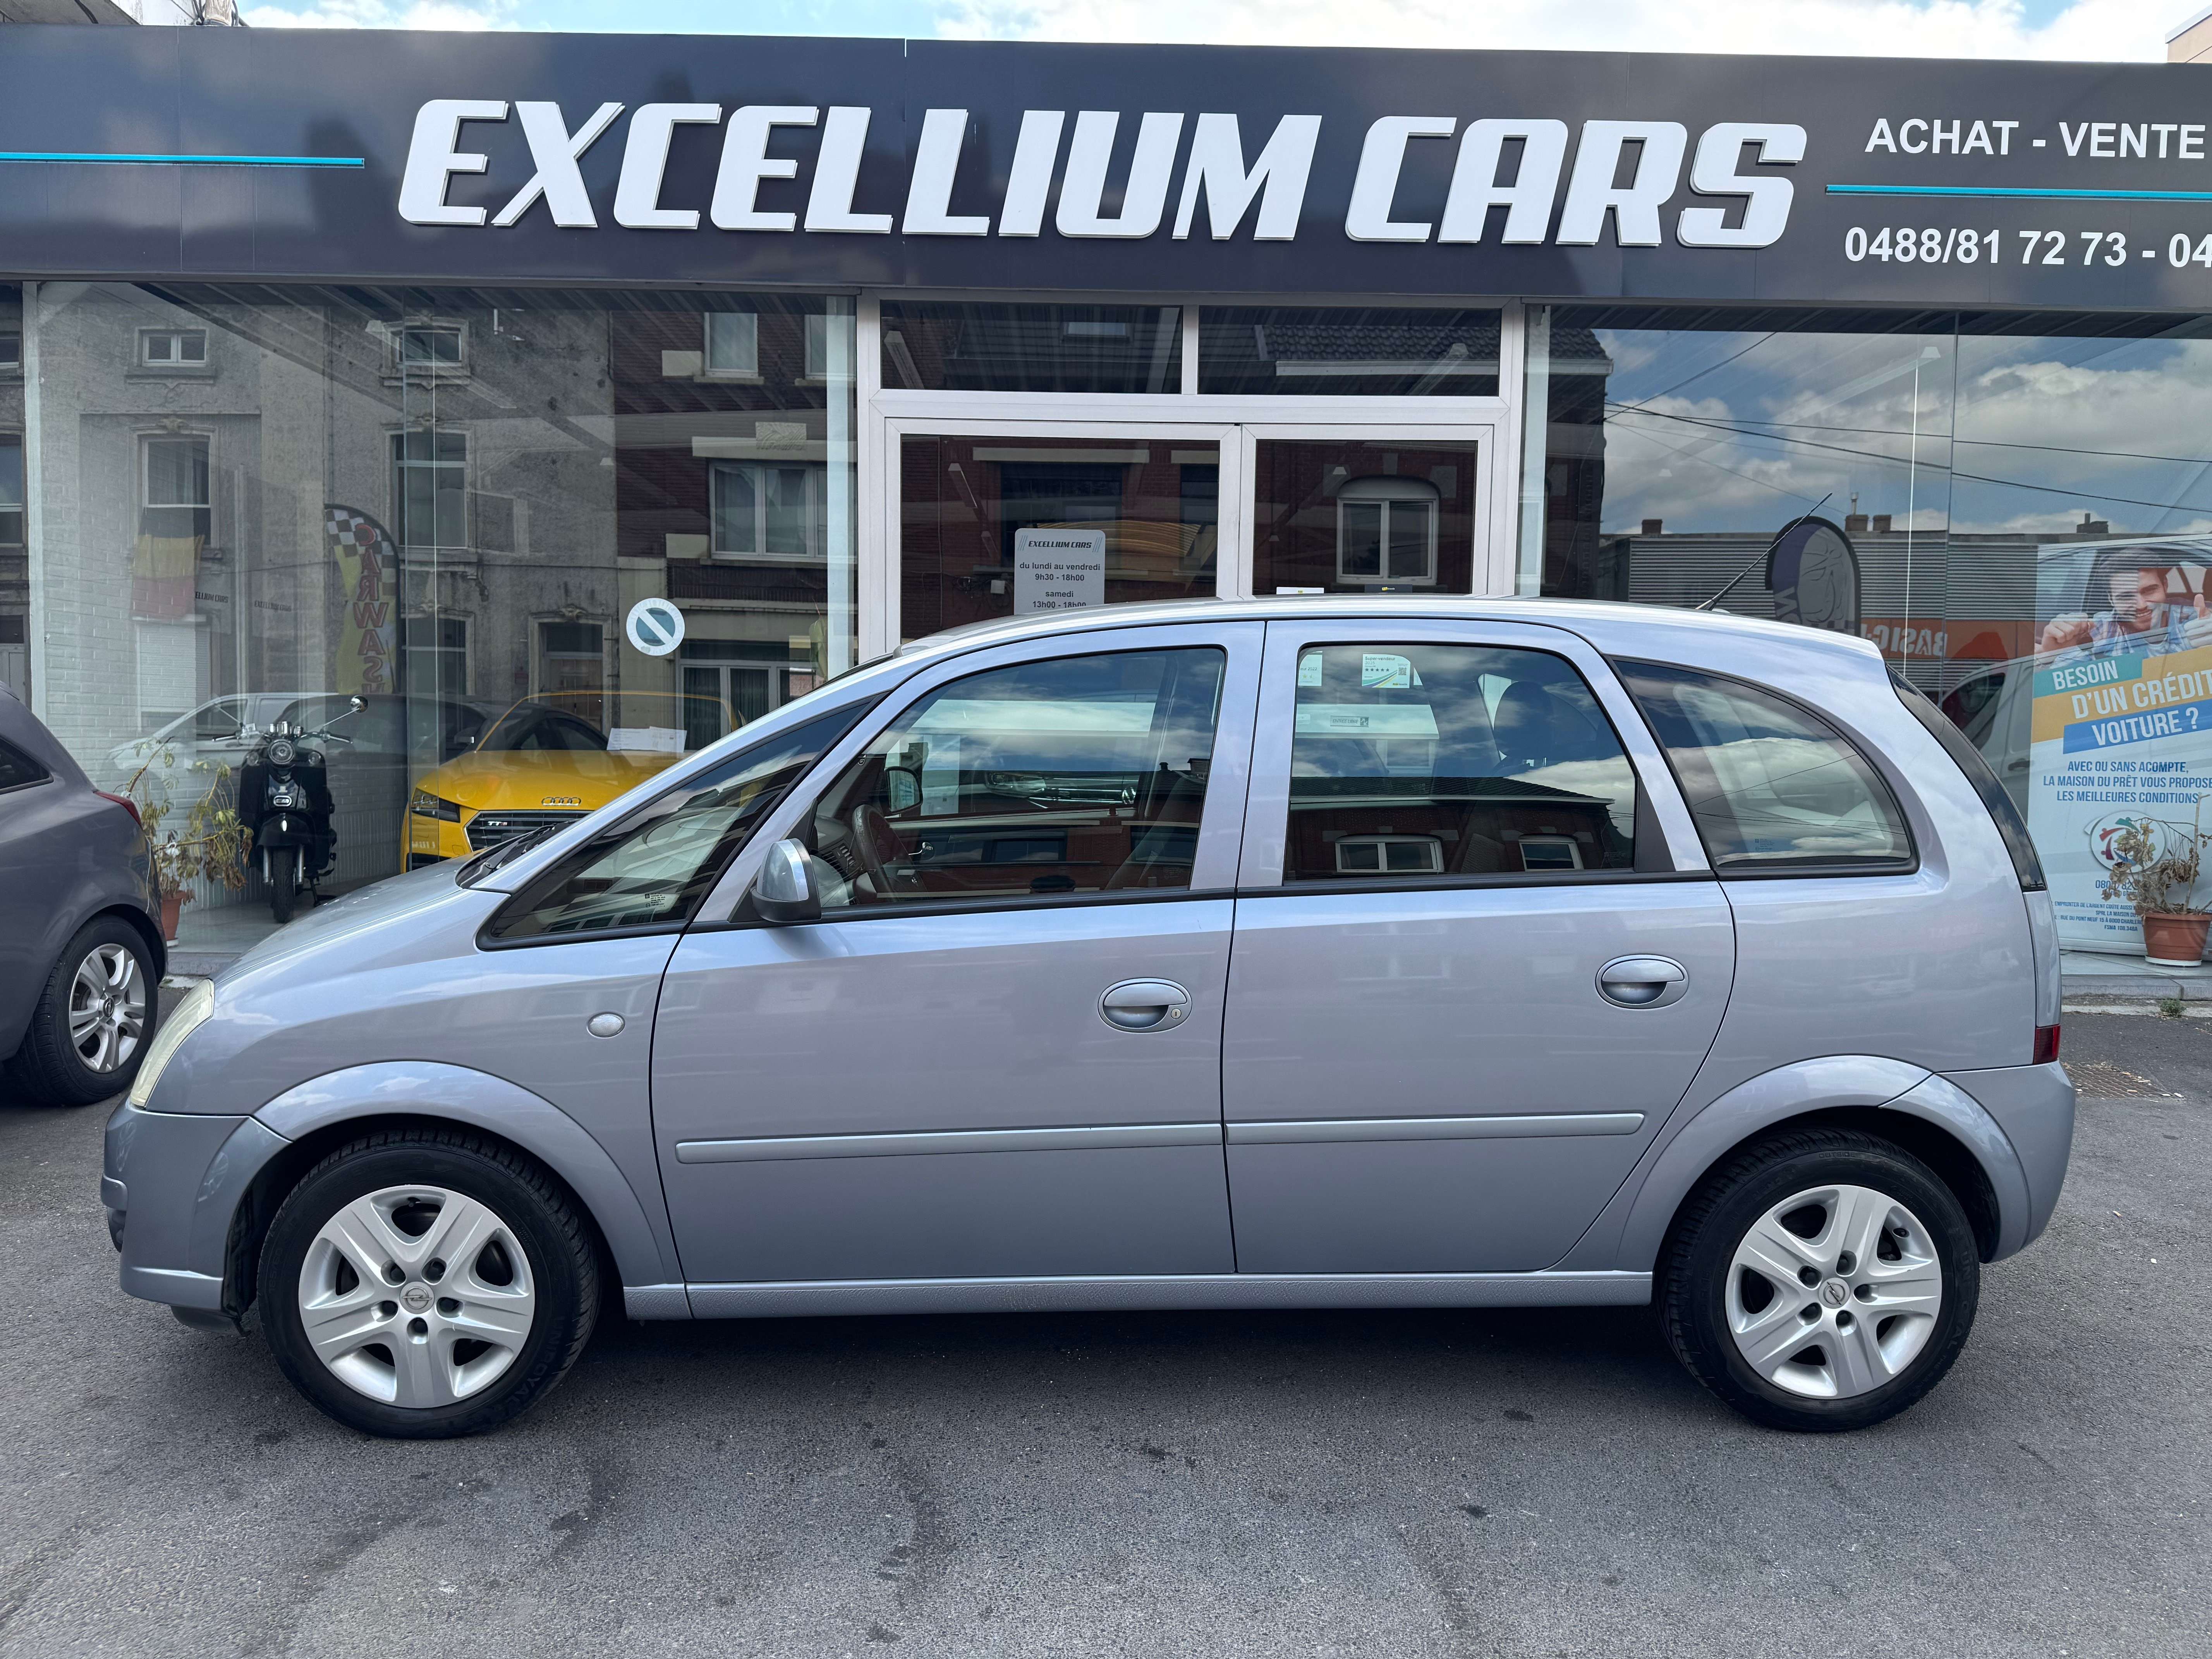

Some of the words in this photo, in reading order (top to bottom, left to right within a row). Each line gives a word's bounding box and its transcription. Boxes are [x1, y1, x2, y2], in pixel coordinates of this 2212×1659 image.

[1865, 118, 2019, 155] ACHAT
[2033, 138, 2046, 147] -
[2058, 122, 2205, 159] VENTE
[398, 99, 1321, 241] EXCELLIUM
[1345, 115, 1807, 249] CARS
[1845, 227, 1999, 264] 0488/81
[2019, 230, 2065, 265] 72
[2080, 232, 2126, 267] 73
[2142, 250, 2155, 258] -
[2169, 233, 2212, 268] 04
[2052, 660, 2118, 690] BESOIN
[2132, 669, 2212, 708] CRÉDIT
[2092, 710, 2182, 745] VOITURE
[2186, 708, 2198, 729] ?
[2043, 776, 2055, 786] LA
[2057, 776, 2094, 787] MAISON
[2097, 776, 2110, 787] DU
[2113, 775, 2138, 787] PRÊT
[2140, 777, 2166, 788] VOUS
[2169, 778, 2212, 788] PROPOSE
[2068, 761, 2092, 771] AVEC
[2095, 761, 2108, 771] OU
[2110, 762, 2136, 772] SANS
[2139, 762, 2189, 774] ACOMPTE,
[2057, 791, 2074, 801] LES
[2076, 791, 2136, 802] MEILLEURES
[2139, 792, 2198, 804] CONDITIONS
